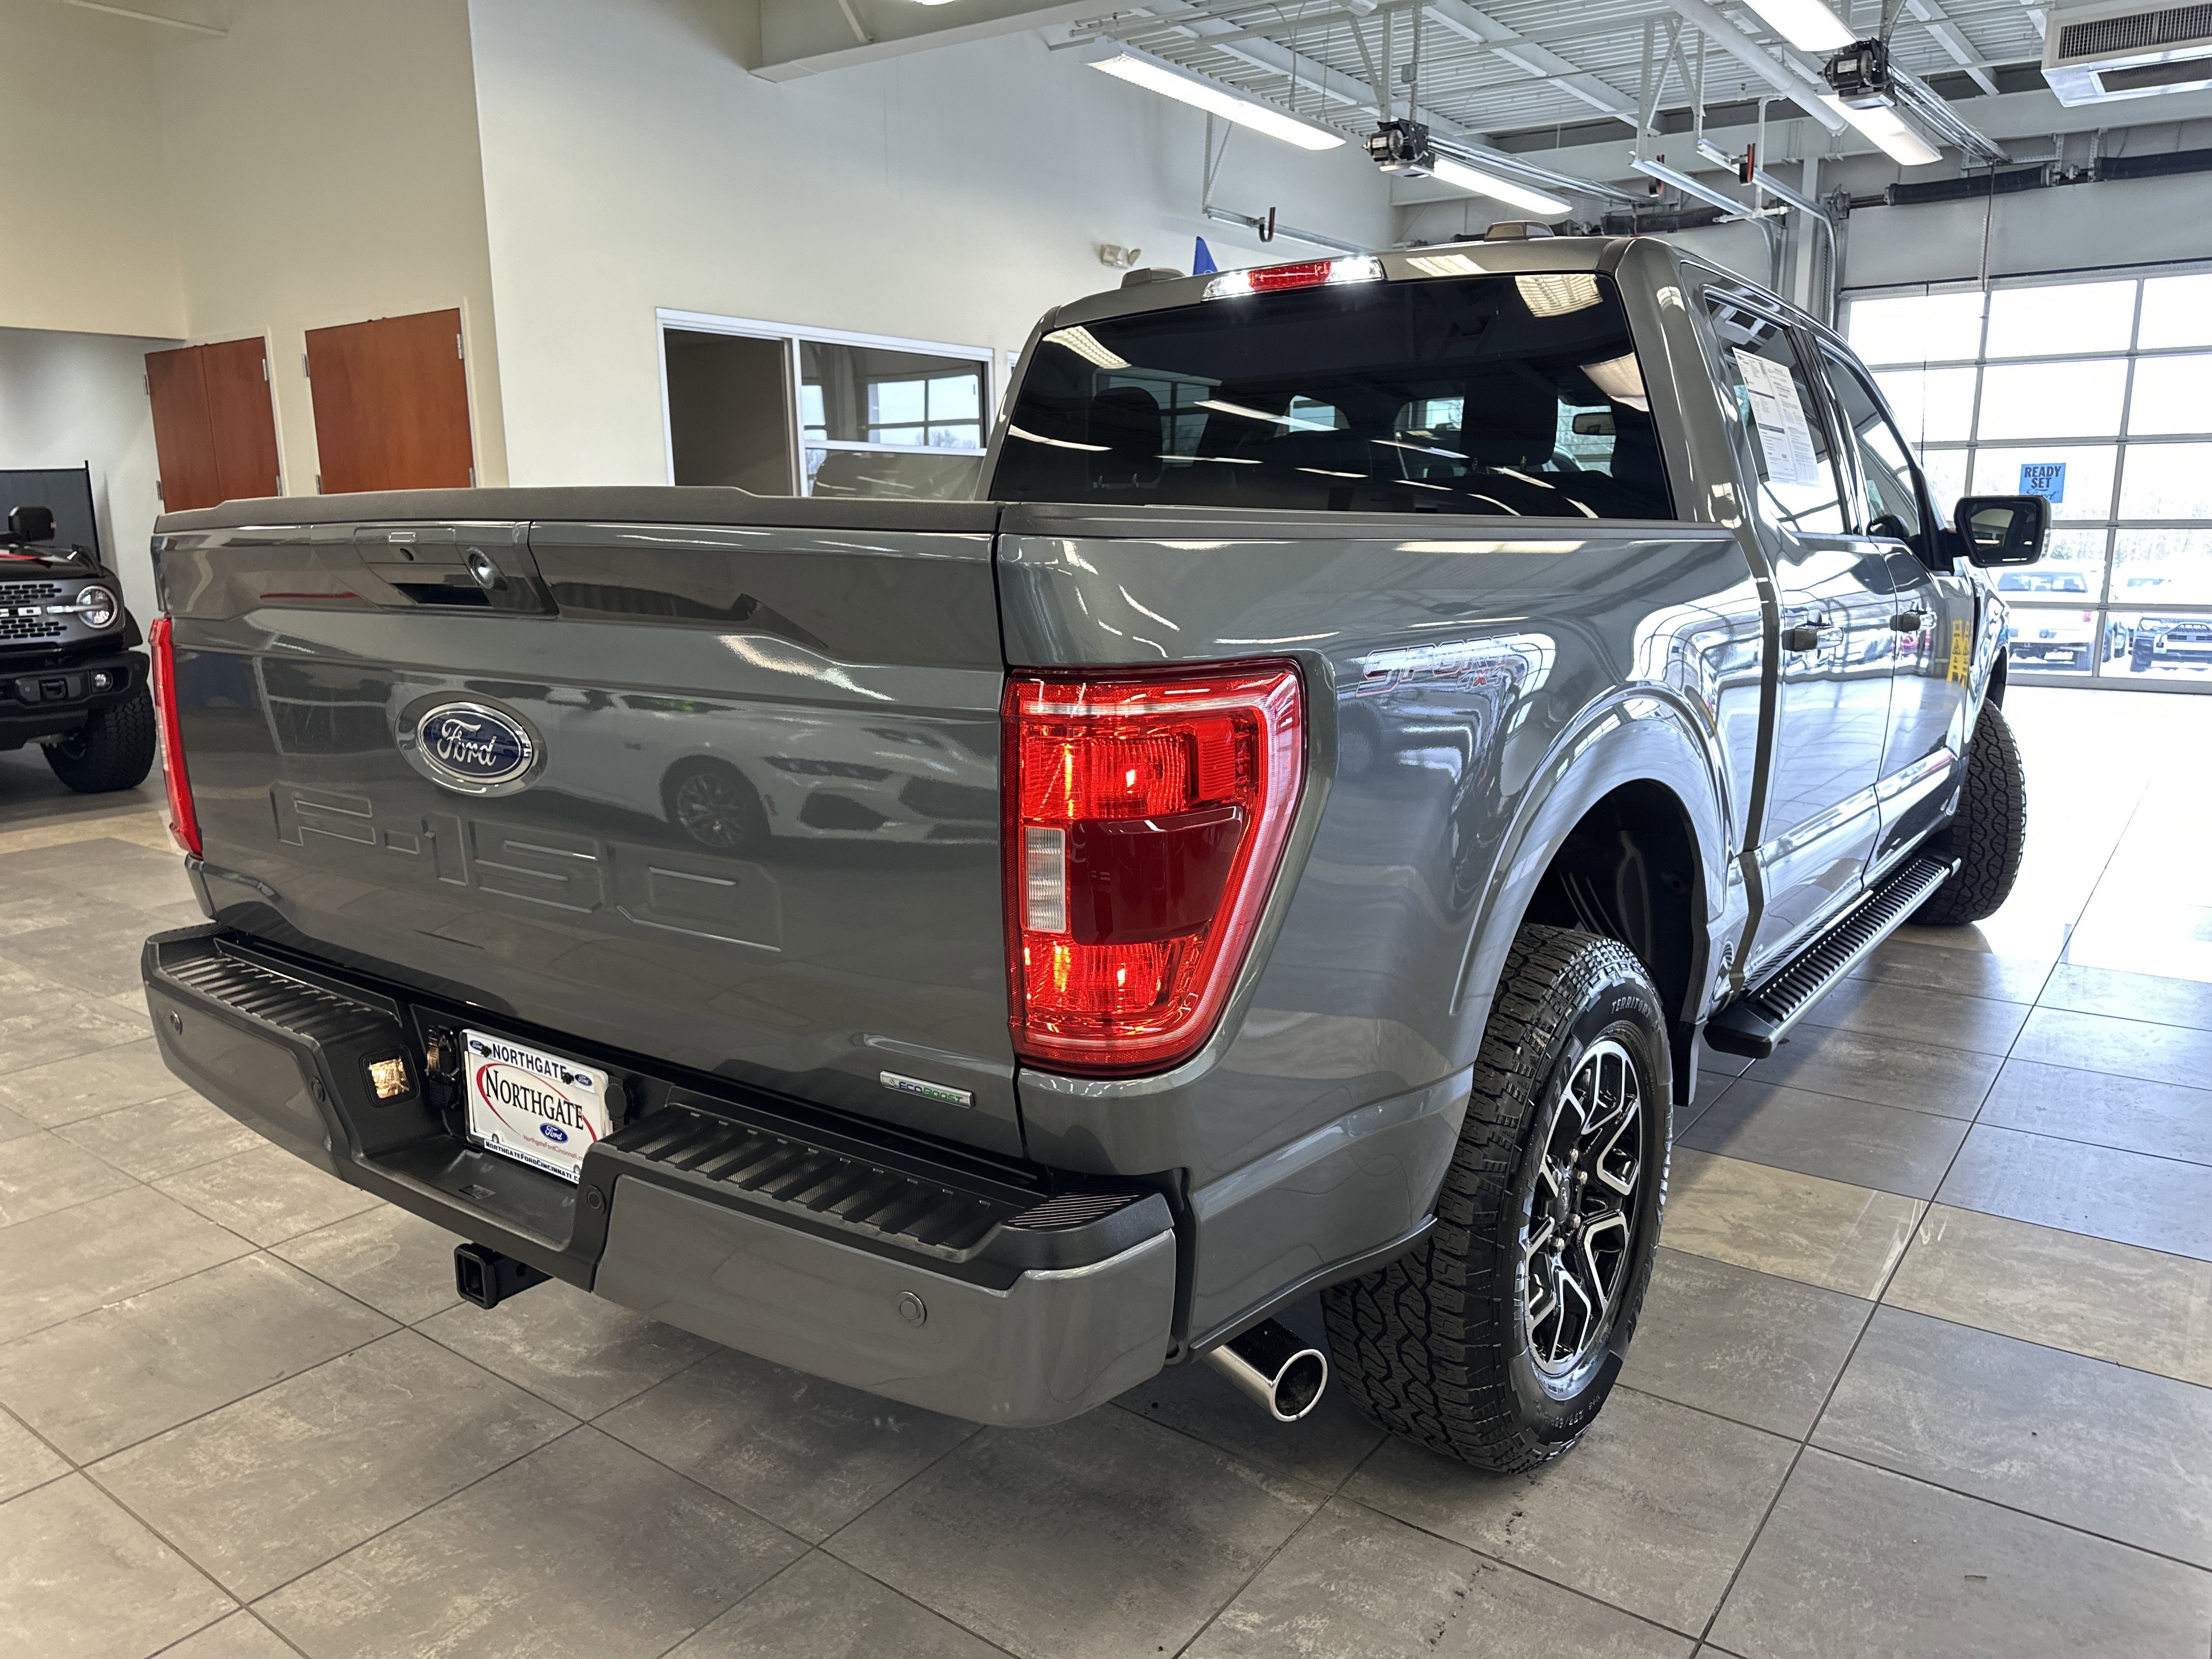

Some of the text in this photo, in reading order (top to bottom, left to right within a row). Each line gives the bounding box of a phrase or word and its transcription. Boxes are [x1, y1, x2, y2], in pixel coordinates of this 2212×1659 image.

[2024, 466, 2062, 478] READY
[2030, 477, 2052, 488] SET
[1356, 633, 1520, 697] SPORT
[437, 718, 497, 766] Ford
[1611, 996, 1652, 1019] TERRITORY
[492, 1043, 567, 1080] NORTHGATE
[485, 1066, 584, 1130] NORTHGATE
[899, 1081, 963, 1103] ECOBOOST
[545, 1125, 563, 1141] Ford
